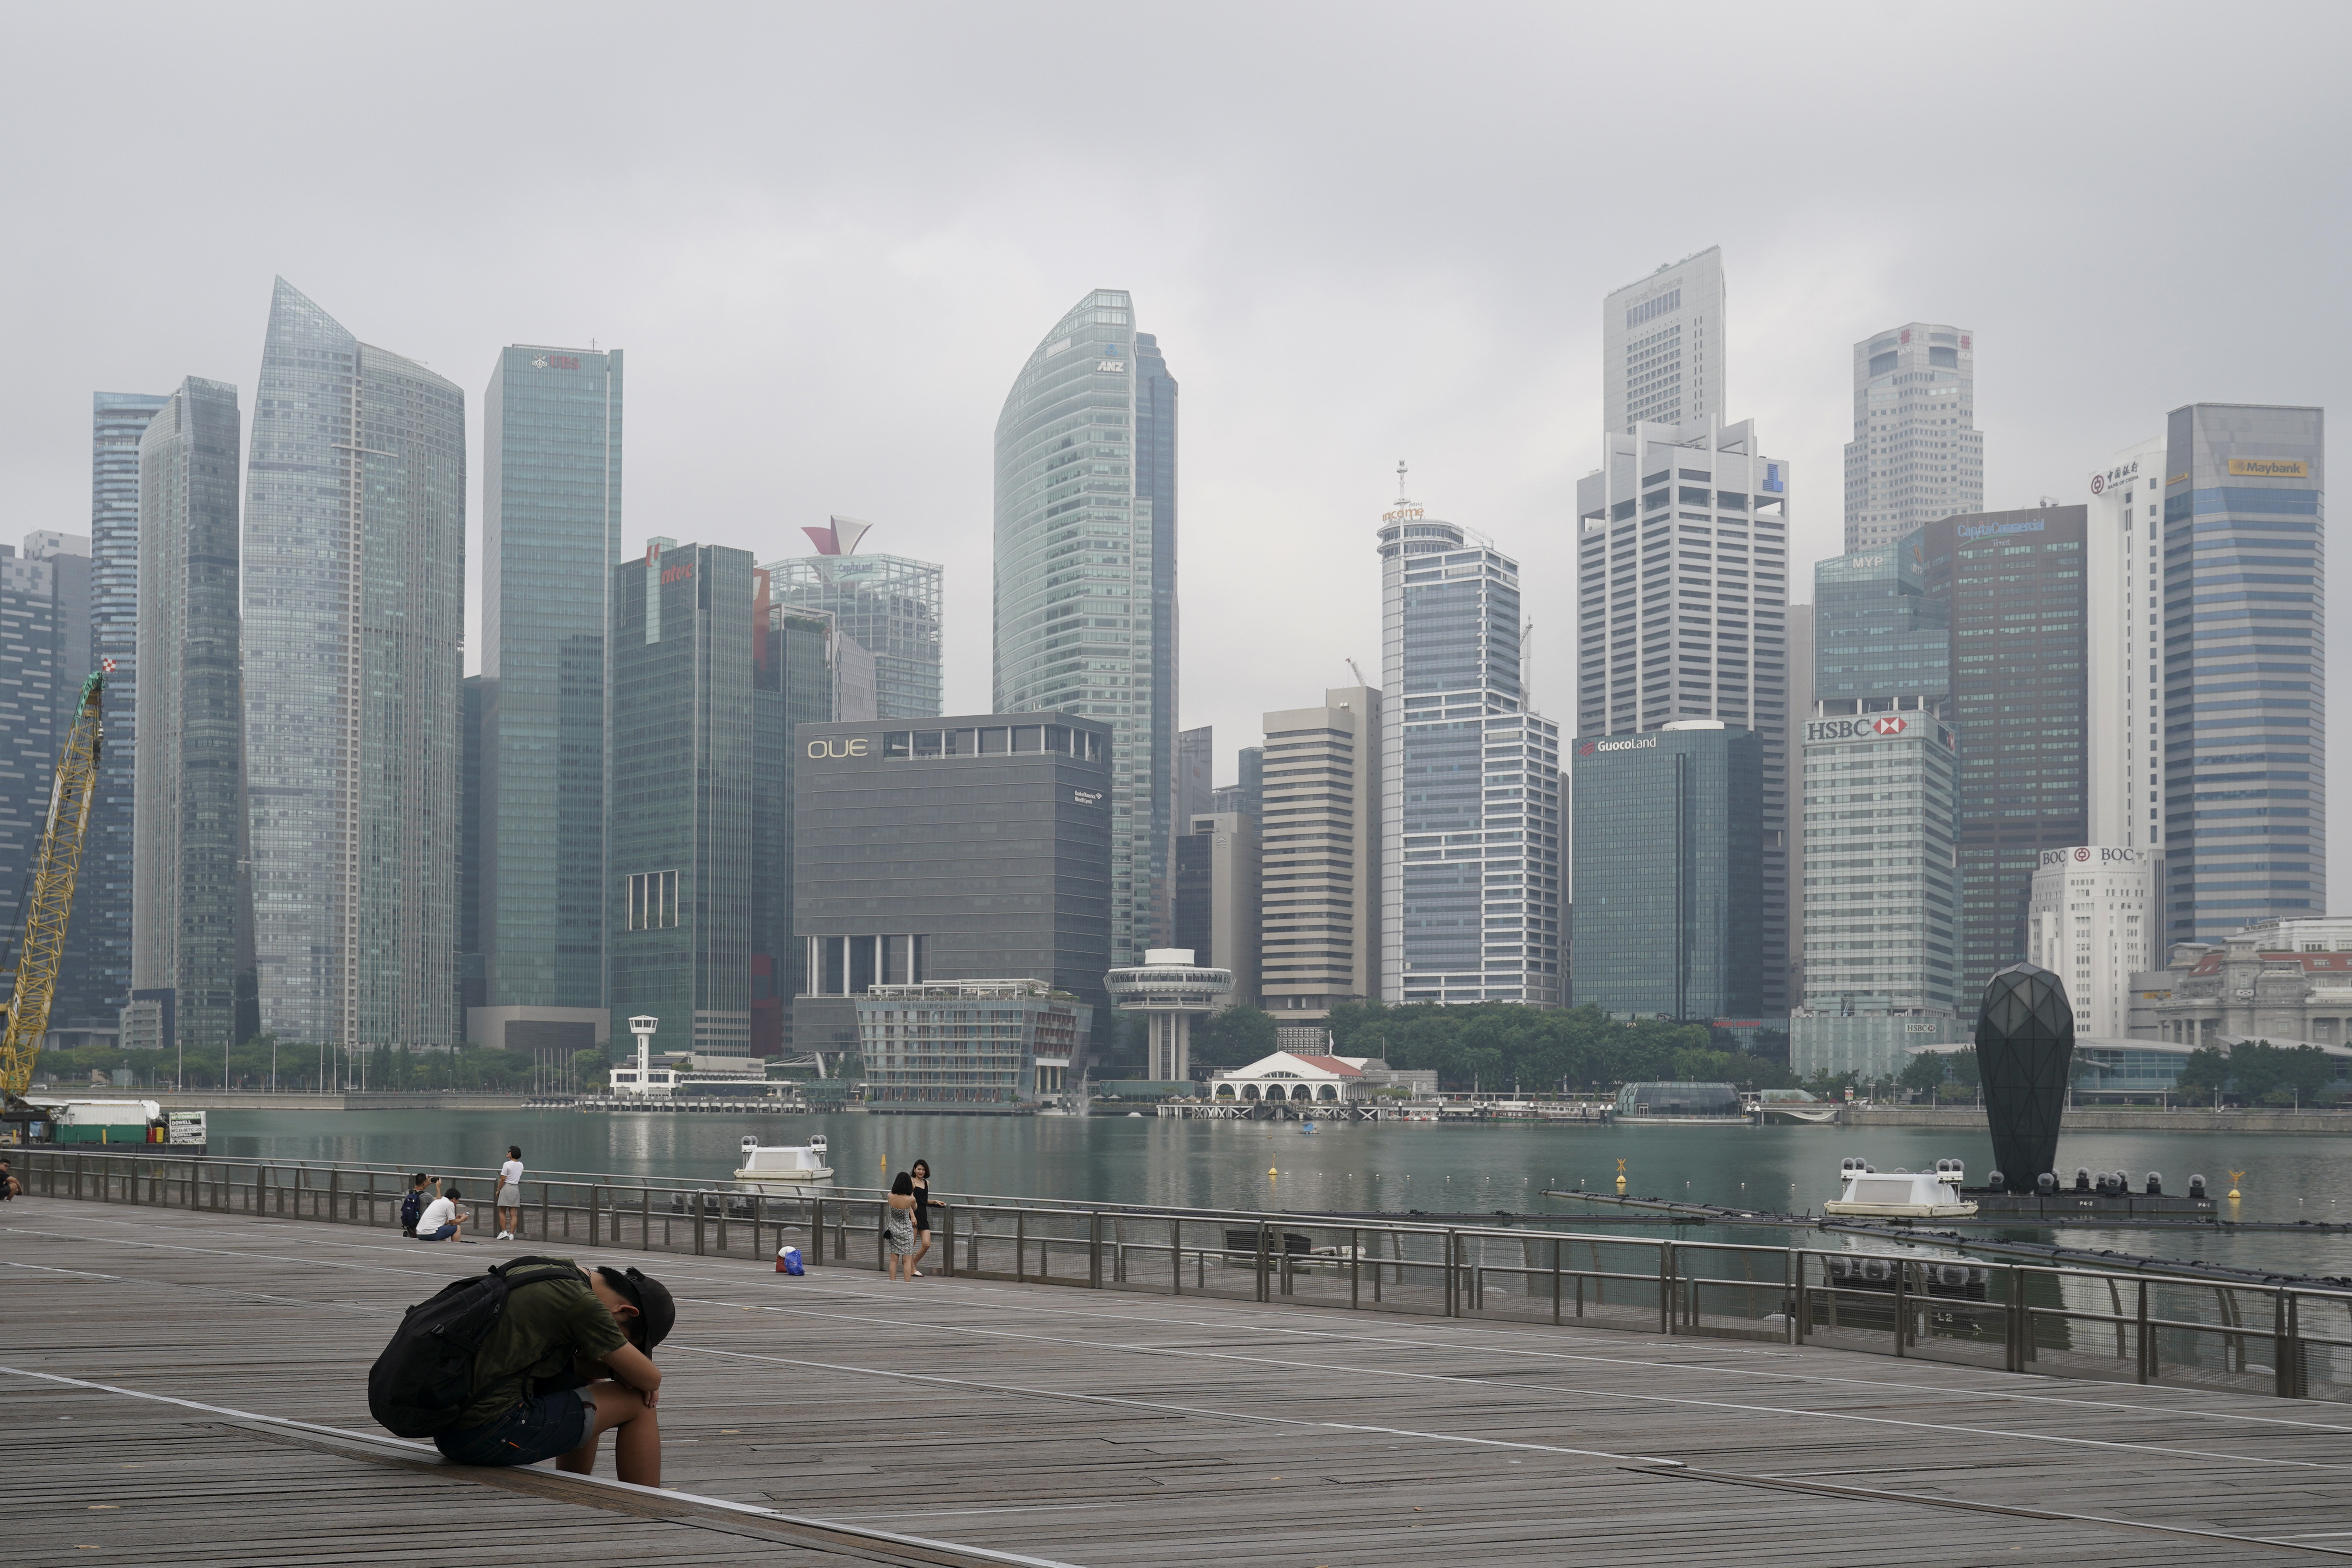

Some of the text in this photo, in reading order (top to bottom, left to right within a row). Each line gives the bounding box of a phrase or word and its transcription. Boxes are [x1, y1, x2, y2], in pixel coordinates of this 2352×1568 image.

[1897, 345, 1914, 356] UOB
[1958, 351, 1973, 360] UOB
[550, 355, 579, 369] UBS
[1096, 361, 1125, 372] ANZ
[2247, 462, 2300, 474] Maybank
[1383, 508, 1424, 522] income
[1957, 518, 2044, 539] CapitaCommercial
[661, 564, 693, 585] ntuc
[839, 561, 873, 574] CapitaLand
[1807, 719, 1870, 740] HSBC
[808, 738, 868, 759] OUE
[1598, 737, 1656, 751] GuocoLand
[2043, 850, 2066, 865] BOC
[2101, 848, 2133, 861] BOC
